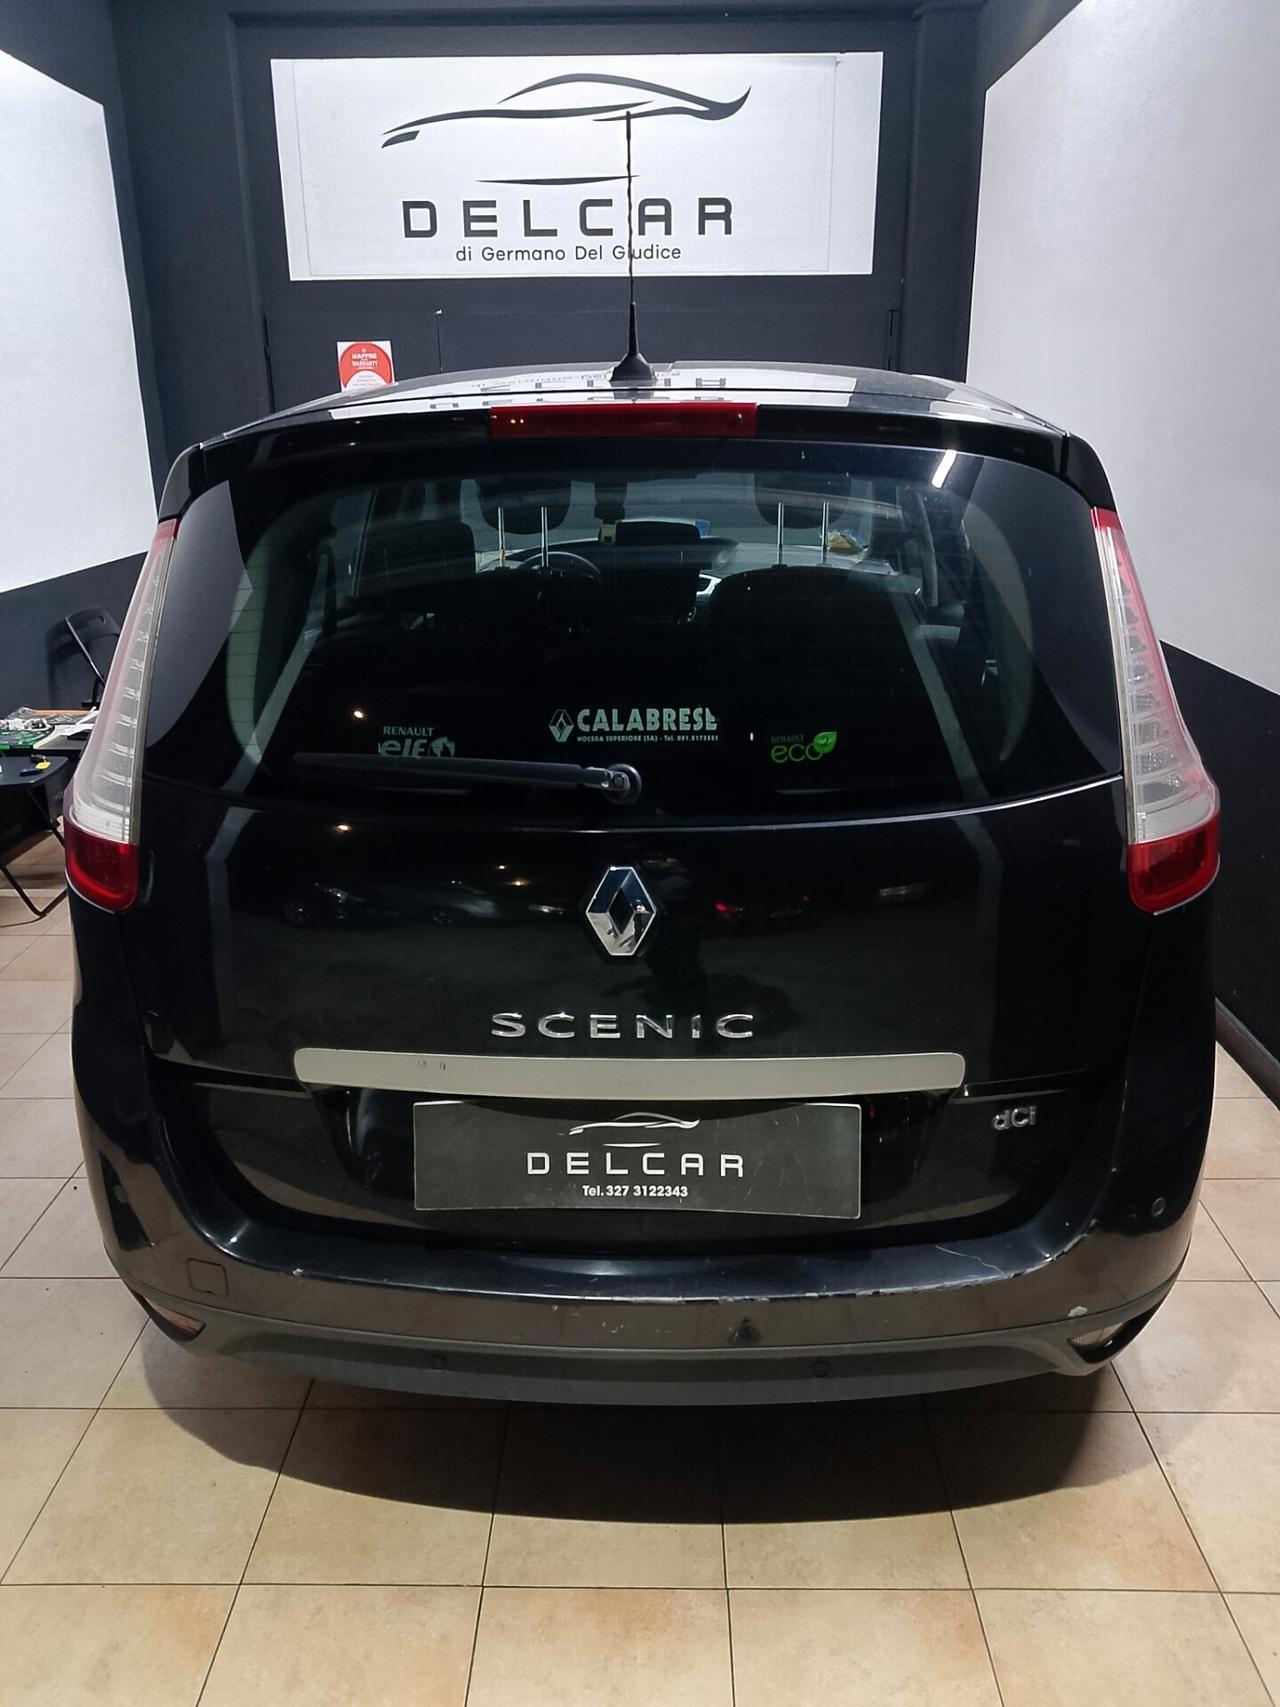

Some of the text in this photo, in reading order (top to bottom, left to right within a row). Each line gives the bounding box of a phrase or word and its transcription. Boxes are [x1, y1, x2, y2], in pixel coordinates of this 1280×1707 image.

[402, 197, 733, 239] DELCAR
[456, 246, 472, 261] di
[481, 246, 566, 261] Germano
[575, 245, 603, 260] Del
[383, 726, 434, 736] RENAULT
[491, 1011, 754, 1039] SCENIC
[993, 1106, 1037, 1131] dCi
[527, 1152, 744, 1178] DELCAR
[582, 1185, 689, 1198] Tel. 327 3122343
